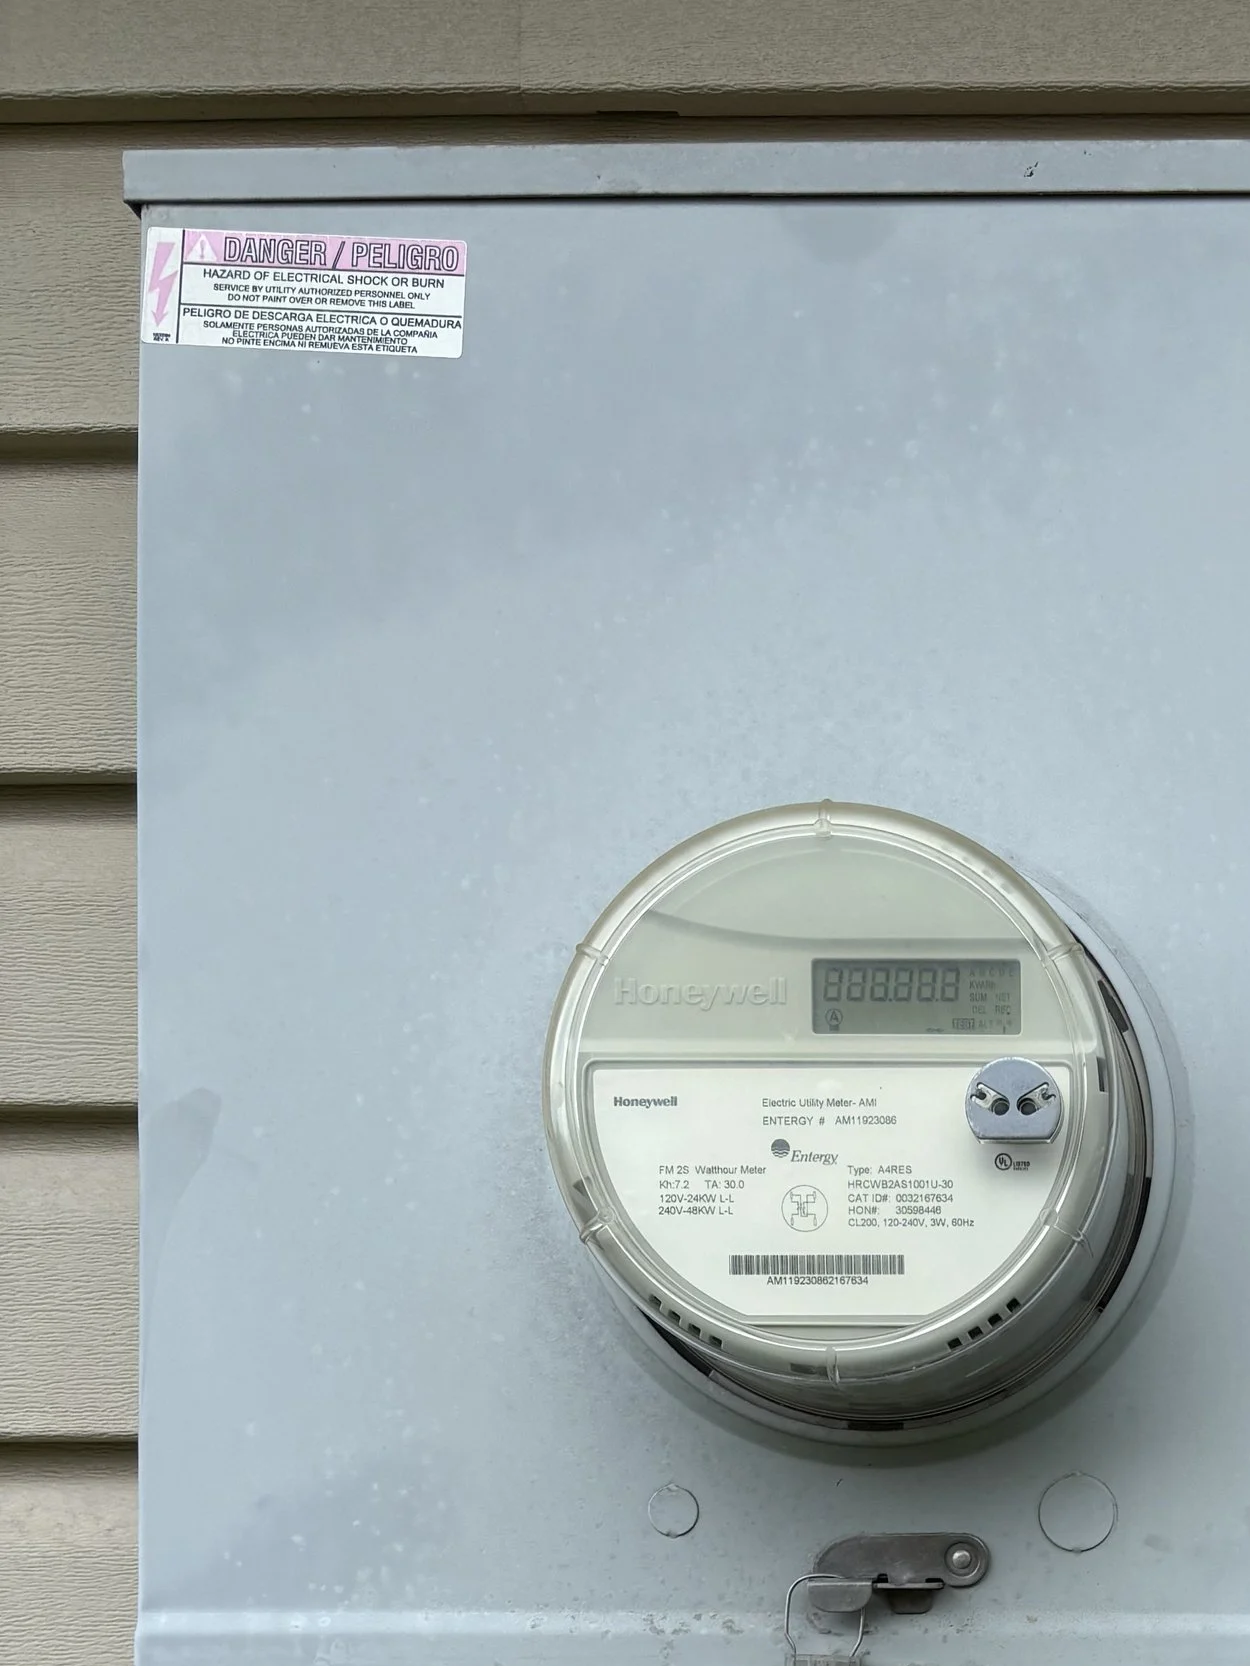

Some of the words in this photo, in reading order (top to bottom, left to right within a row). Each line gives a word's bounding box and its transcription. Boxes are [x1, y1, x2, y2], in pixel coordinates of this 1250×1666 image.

[224, 237, 326, 266] DANGER
[332, 241, 345, 270] /
[352, 242, 459, 271] PELIGRO
[204, 269, 250, 280] HAZARD
[254, 271, 270, 281] OF
[273, 272, 343, 284] ELECTRICAL
[347, 276, 388, 286] SHOCK
[391, 278, 408, 287] OR
[412, 278, 444, 288] BURN
[214, 284, 249, 292] SERVICE
[265, 286, 296, 294] UTILITY
[299, 289, 352, 297] AUTHORIZED
[355, 290, 405, 299] PERSONNEL
[408, 292, 430, 300] ONLY
[183, 308, 231, 318] PELIGRO
[234, 310, 249, 319] DE
[252, 310, 313, 322] DESCARGA
[316, 315, 377, 325] ELECTRICA
[380, 317, 388, 325] O
[391, 318, 461, 329] QUEMADURA
[233, 331, 279, 339] ELECTRICA
[281, 332, 316, 341] PUEDEN
[338, 336, 407, 345] MANTENIMIENTO
[614, 977, 787, 1011] Honeywell
[613, 1097, 678, 1108] Honeywell
[762, 1099, 796, 1107] Electric
[799, 1099, 824, 1109] Utility
[859, 1099, 877, 1107] AMI
[763, 1117, 813, 1126] ENTERGY
[819, 1117, 825, 1125] #
[835, 1116, 896, 1125] AM11923086
[791, 1150, 838, 1165] Entergy
[659, 1166, 674, 1174] FM
[677, 1166, 689, 1174] 2S
[695, 1166, 737, 1174] Watthour
[741, 1166, 766, 1174] Meter
[848, 1165, 872, 1176] Type:
[878, 1166, 912, 1174] A4RES
[659, 1180, 689, 1189] Kh:7.2
[705, 1180, 721, 1189] TA:
[724, 1180, 744, 1189] 30.0
[660, 1194, 716, 1203] 120V-24KW
[720, 1195, 734, 1203] L-L
[848, 1194, 869, 1202] CAT
[659, 1206, 716, 1215] 240V-48KW
[719, 1207, 733, 1215] L-L
[848, 1218, 879, 1227] CL200,
[883, 1218, 927, 1227] 120-240V,
[931, 1218, 948, 1227] 3W,
[952, 1218, 974, 1226] 60Hz
